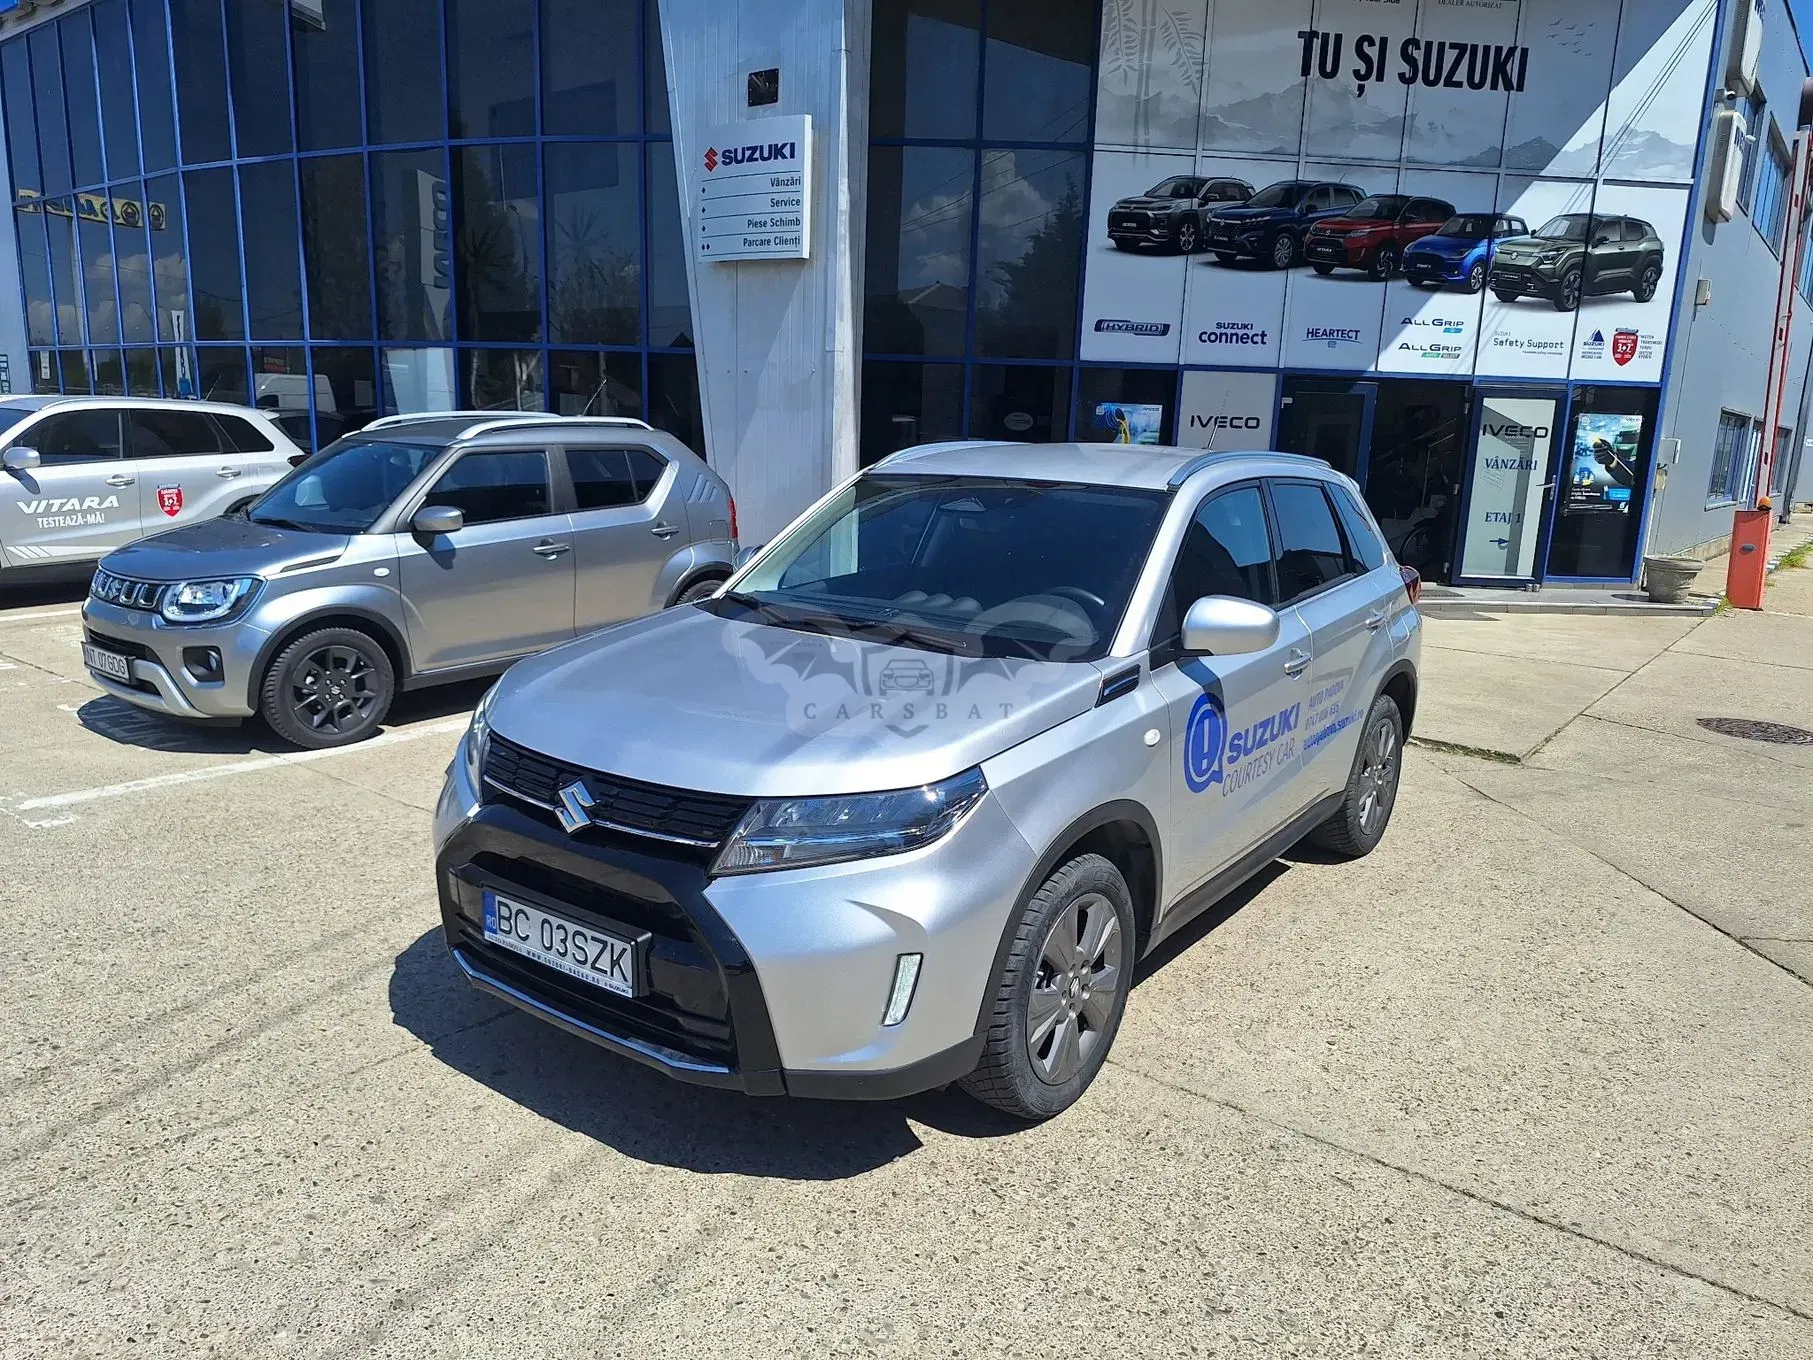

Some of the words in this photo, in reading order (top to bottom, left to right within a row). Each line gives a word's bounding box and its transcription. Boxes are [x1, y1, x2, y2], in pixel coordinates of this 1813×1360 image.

[1298, 30, 1343, 79] TU
[1352, 34, 1389, 97] ȘI
[1398, 37, 1529, 92] SUZUKI
[721, 142, 795, 166] SUZUKI
[770, 176, 801, 187] Vânzări
[770, 197, 801, 208] Service
[747, 218, 768, 229] Piese
[770, 217, 800, 228] Schimb
[743, 236, 771, 248] Parcare
[774, 234, 800, 248] Clienți
[1105, 322, 1160, 333] HYBRID
[1215, 322, 1254, 330] SUZUKI
[1199, 330, 1268, 345] connect
[1306, 328, 1360, 341] HEARTECT
[1493, 337, 1524, 348] Safety
[1526, 339, 1564, 350] Support
[1190, 415, 1260, 429] IVECO
[1482, 424, 1548, 438] IVECO
[1485, 456, 1538, 471] VÂNZĂRI
[16, 495, 119, 514] VITARA
[1485, 512, 1512, 525] ETAJ
[1515, 512, 1521, 523] 1
[1226, 702, 1301, 765] SUZUKI
[1222, 754, 1274, 797] COURTESY
[1276, 737, 1295, 764] CAR
[486, 915, 496, 930] RO
[497, 900, 530, 941] BC
[541, 918, 628, 983] 03SZK
